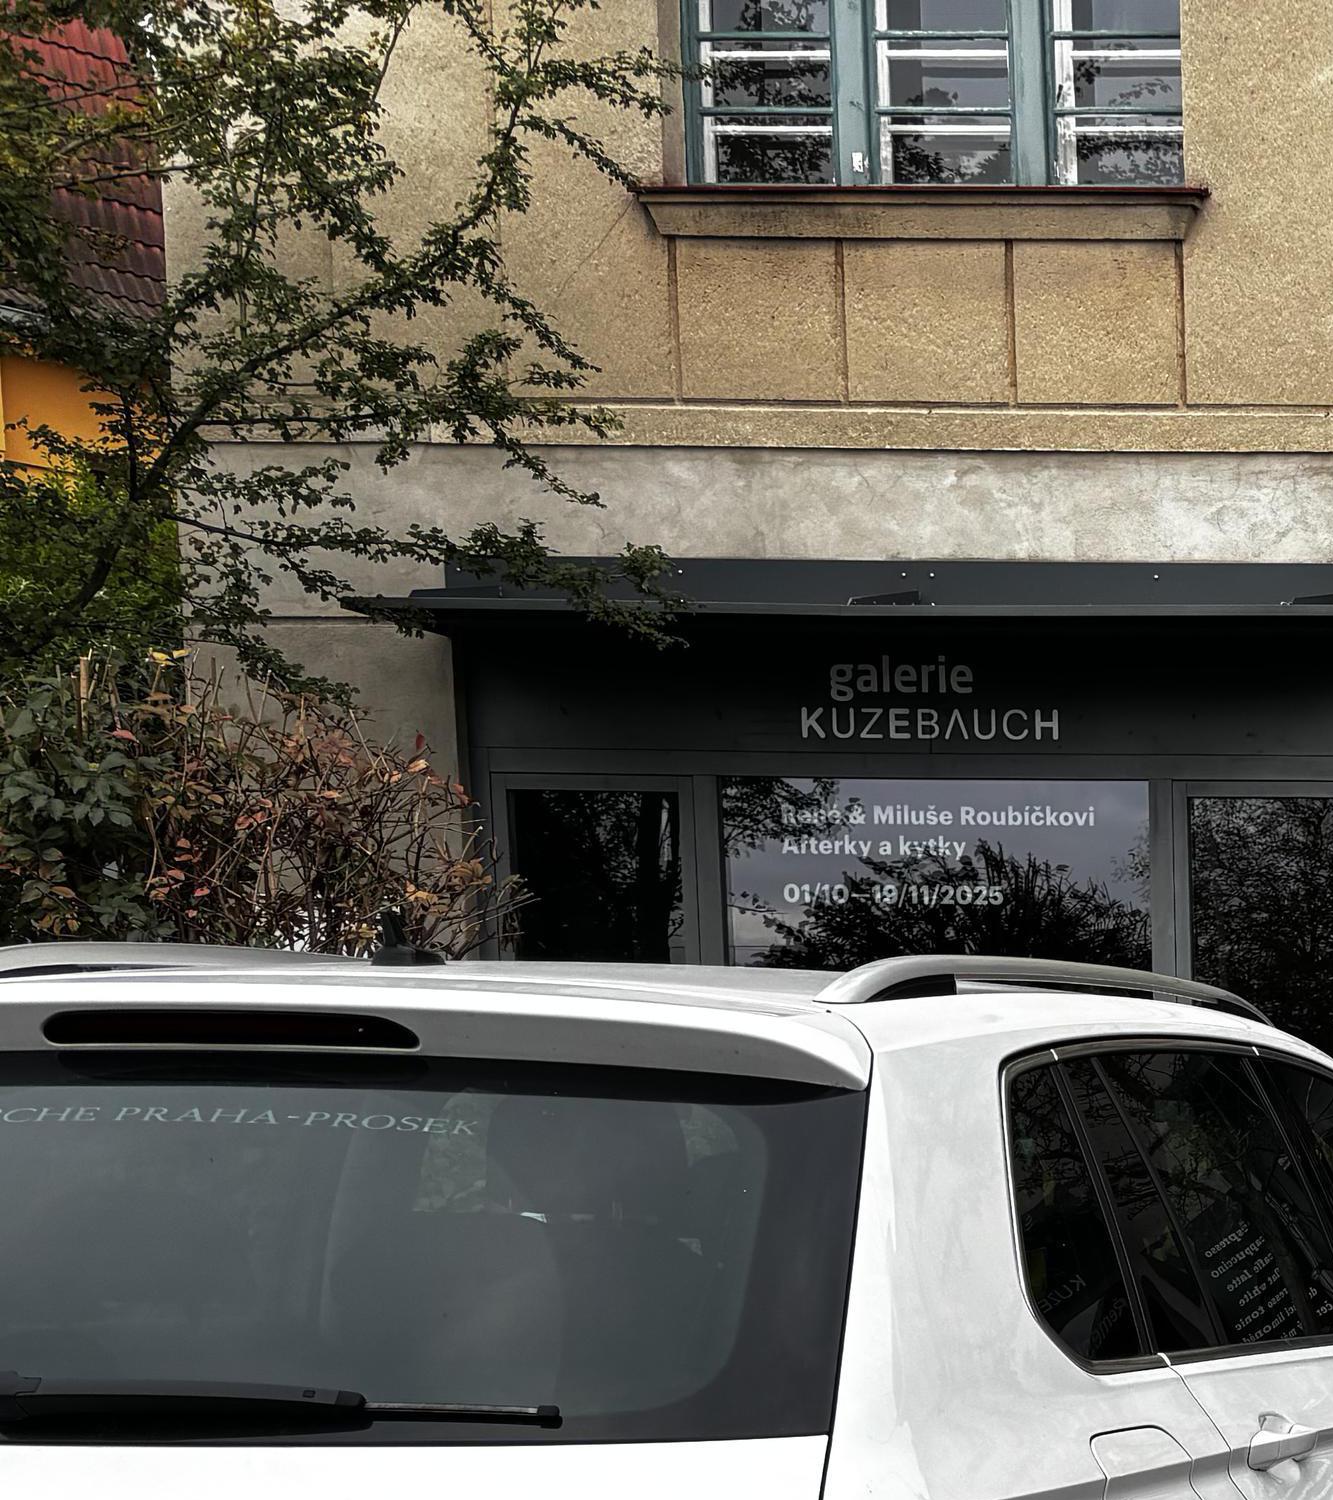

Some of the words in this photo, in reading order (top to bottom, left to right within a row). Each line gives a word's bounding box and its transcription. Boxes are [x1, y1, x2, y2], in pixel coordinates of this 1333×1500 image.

[829, 654, 974, 702] galerie
[800, 706, 1061, 741] KUZEBAUCH
[849, 804, 866, 825] &
[872, 804, 953, 826] Miluše
[960, 805, 1095, 827] Roubíčkovi
[879, 839, 892, 856] a
[899, 836, 966, 859] kytky
[0, 1106, 101, 1124] CHE
